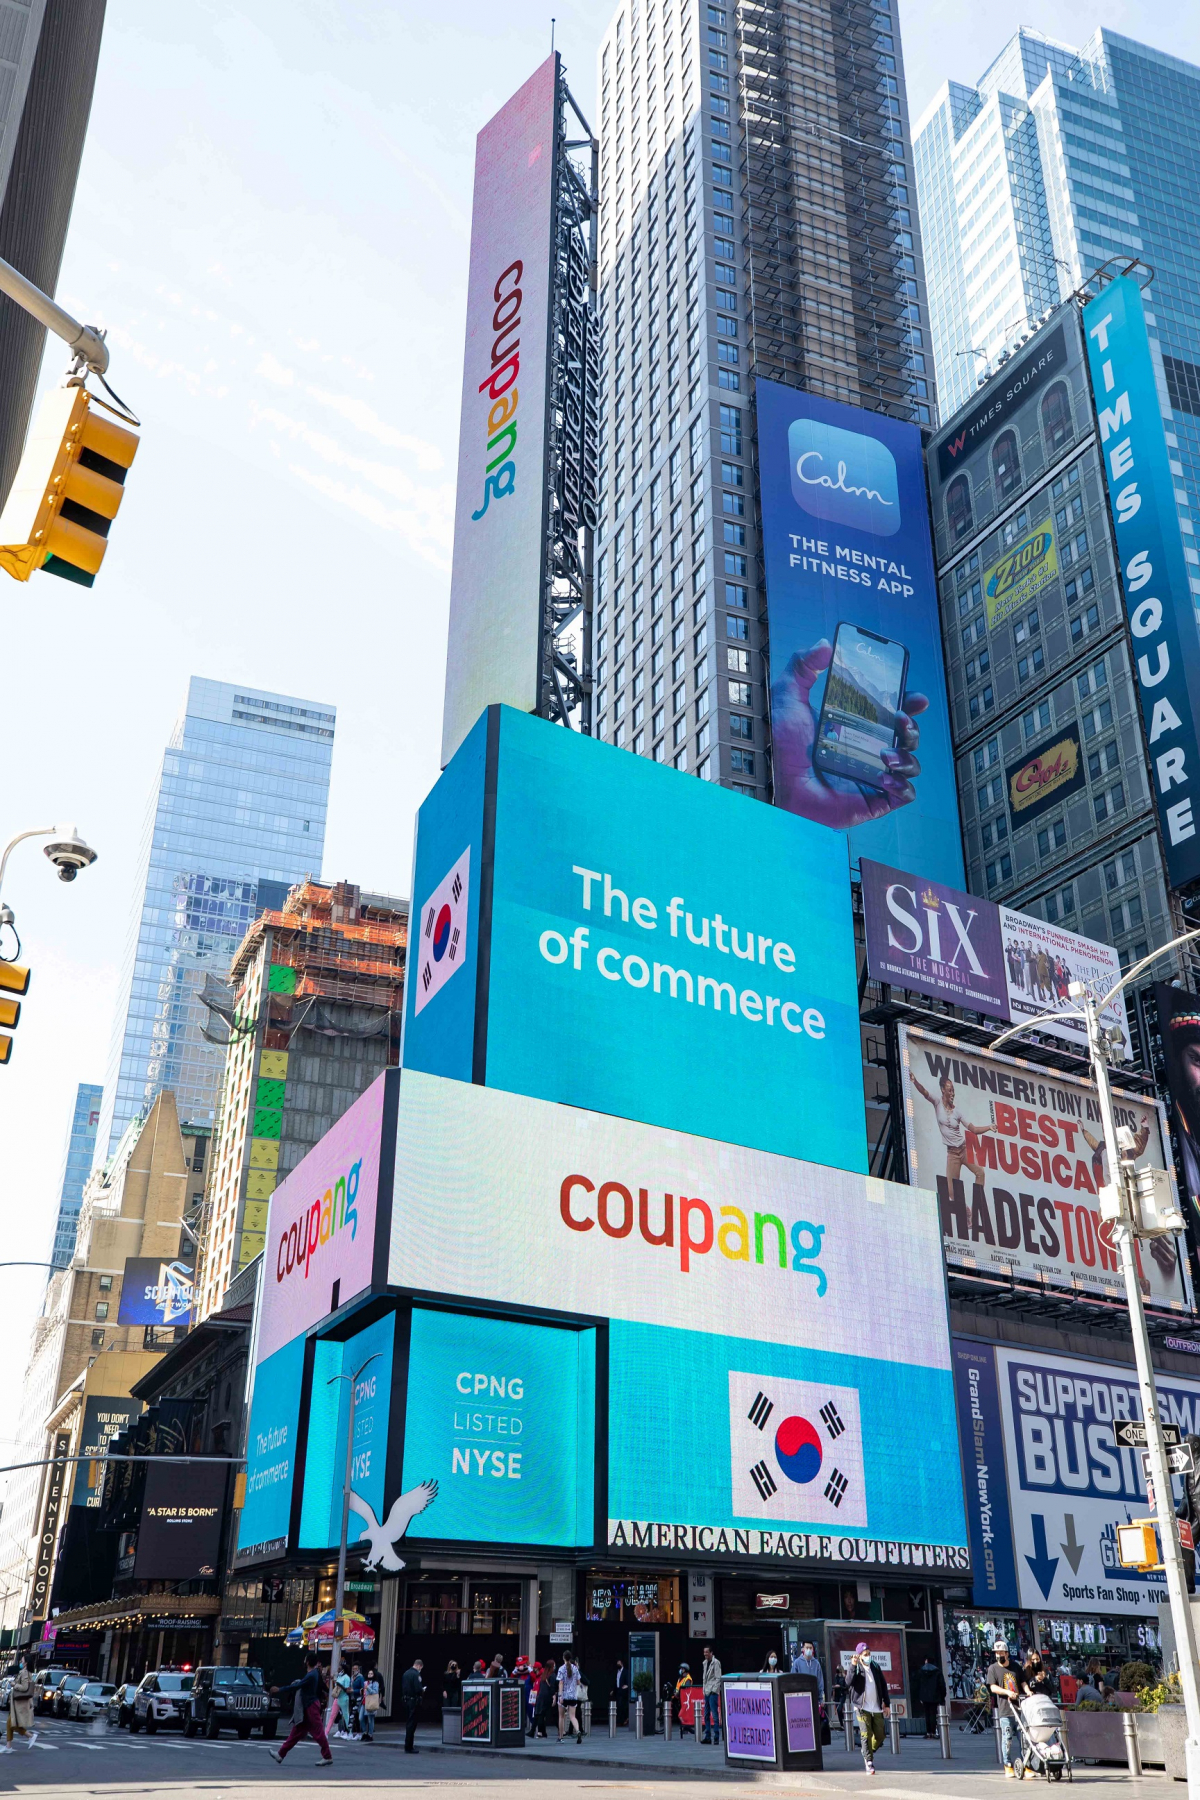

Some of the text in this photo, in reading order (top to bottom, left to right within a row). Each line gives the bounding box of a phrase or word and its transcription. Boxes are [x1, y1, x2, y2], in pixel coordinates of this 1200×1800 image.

[471, 259, 524, 521] coupang
[562, 230, 585, 569] AMERICAN EAGLE
[947, 349, 1054, 457] W TIMES SQUARE
[582, 303, 600, 531] OUTFITTERS
[796, 451, 893, 505] Calm
[789, 533, 912, 580] THE MENTAL
[789, 553, 914, 598] FITNESS APP
[994, 532, 1046, 599] Z100
[991, 569, 1056, 627] Hit Music Station
[995, 562, 1049, 613] New York's #1
[1090, 312, 1196, 847] TIMES SQUARE
[856, 642, 884, 662] Calm
[572, 864, 796, 973] The future
[886, 884, 989, 978] SIX
[1005, 914, 1110, 958] BROADWAY'S FUNNIEST SMASH HIT
[1003, 922, 1114, 967] AND INTERNATIONAL PHENOMENON
[538, 926, 826, 1039] of commerce
[910, 955, 972, 986] THE MUSICAL
[1075, 963, 1114, 984] THE PLAY
[924, 1051, 1036, 1105] WINNER!
[1038, 1084, 1047, 1108] 8
[1048, 1087, 1083, 1122] TONY
[994, 1101, 1079, 1153] BEST
[276, 1157, 362, 1283] coupang
[559, 1173, 828, 1298] coupang
[957, 1352, 987, 1363] SHOP ONLINE
[354, 1376, 377, 1406] CPNG
[456, 1372, 524, 1400] CPNG
[97, 1413, 130, 1424] YOU DON'T
[104, 1424, 119, 1434] NEED
[453, 1412, 523, 1435] LISTED
[1125, 1428, 1145, 1440] ONE
[256, 1425, 288, 1457] The future
[451, 1447, 522, 1479] NYSE
[1169, 1453, 1184, 1466] WAY
[255, 1459, 289, 1490] commerce
[157, 1507, 177, 1516] STAR
[178, 1507, 187, 1516] IS
[613, 1521, 970, 1570] AMERICAN EAGLE OUTFITTERS
[350, 1582, 373, 1592] Broadway
[1062, 1583, 1095, 1601] Sports
[1097, 1586, 1114, 1601] Fan
[1116, 1587, 1140, 1605] Shop
[1051, 1621, 1107, 1644] GRAND
[729, 1725, 771, 1747] LA LIBERTAD?
